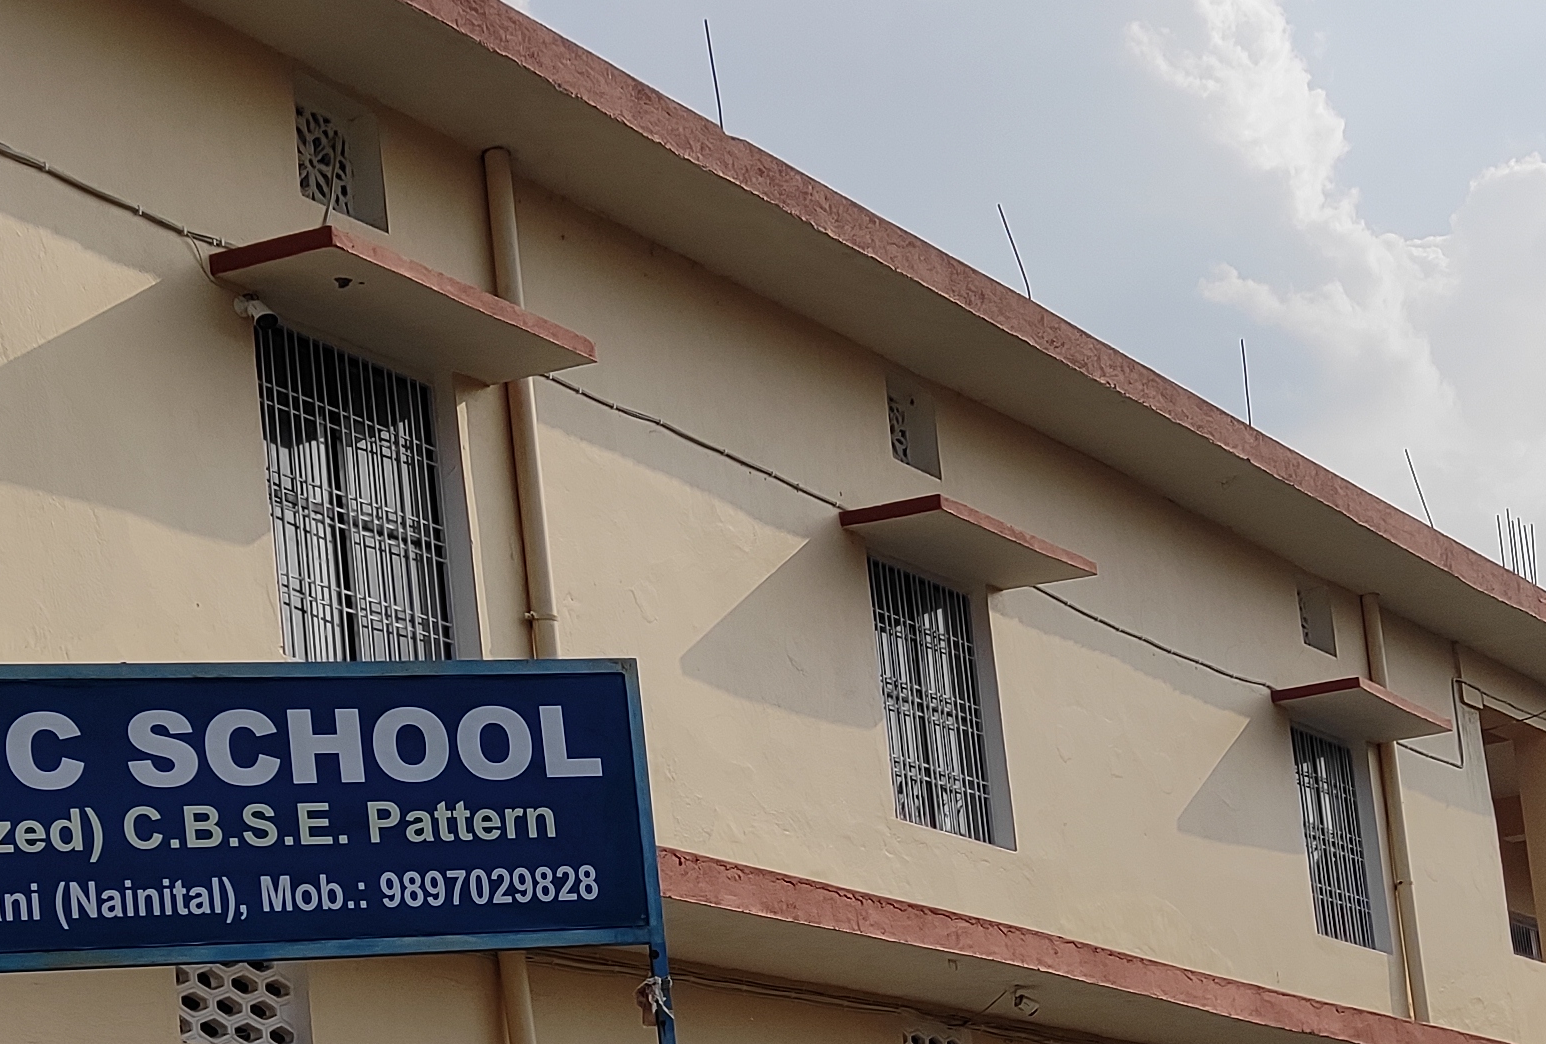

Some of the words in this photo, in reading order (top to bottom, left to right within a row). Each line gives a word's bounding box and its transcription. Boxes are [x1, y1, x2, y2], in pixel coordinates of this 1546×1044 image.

[127, 705, 603, 788] SCHOOL
[123, 801, 348, 850] C.B.S.E.
[367, 800, 556, 843] Pattern
[55, 876, 247, 930] (Nainital),
[260, 874, 365, 912] Mob.:
[379, 864, 599, 908] 9897029828
